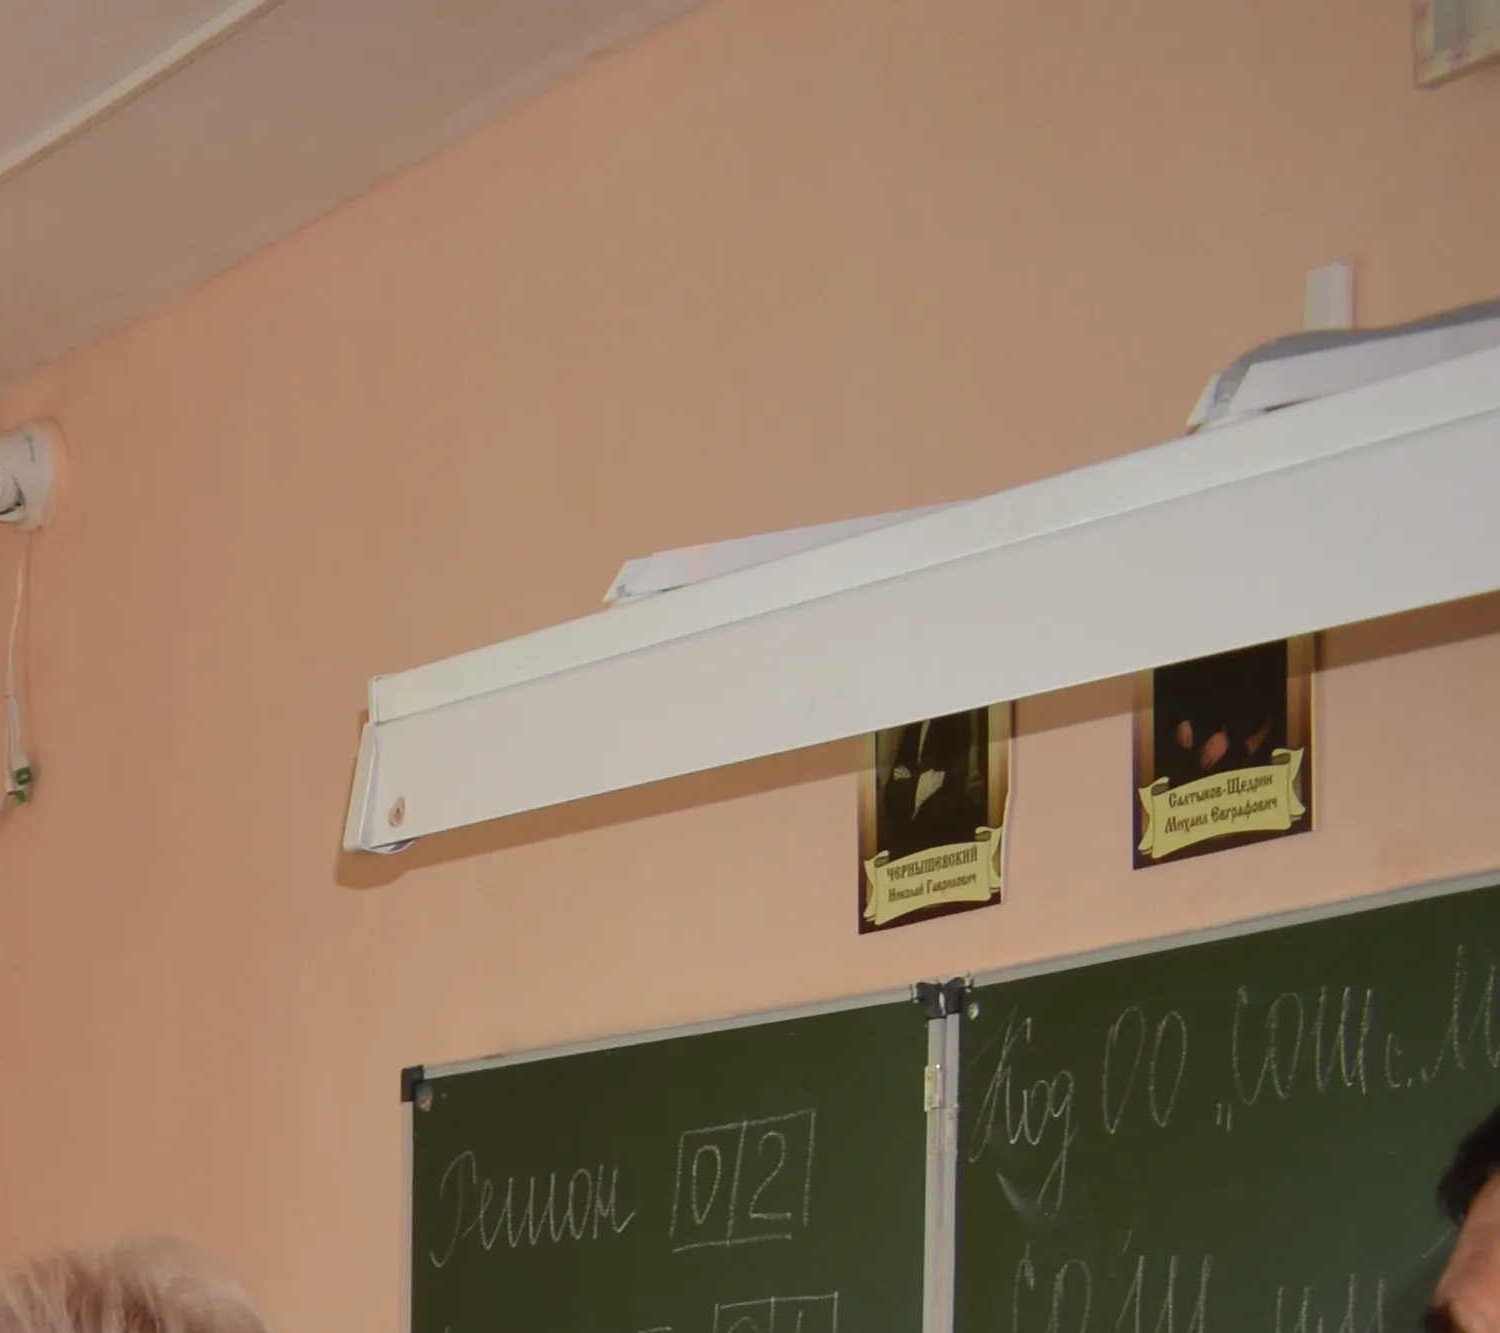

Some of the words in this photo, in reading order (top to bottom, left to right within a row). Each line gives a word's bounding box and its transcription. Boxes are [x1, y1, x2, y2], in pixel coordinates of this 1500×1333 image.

[1168, 773, 1274, 809] Салтыков-Щедрин
[1164, 813, 1209, 835] Михаил
[1210, 797, 1278, 823] Евграфович
[886, 844, 978, 882] ЧЕРНЫШЕВСКИЙ
[888, 882, 925, 903] Николай
[926, 872, 977, 895] Гаврилович
[429, 1150, 635, 1267] Регион
